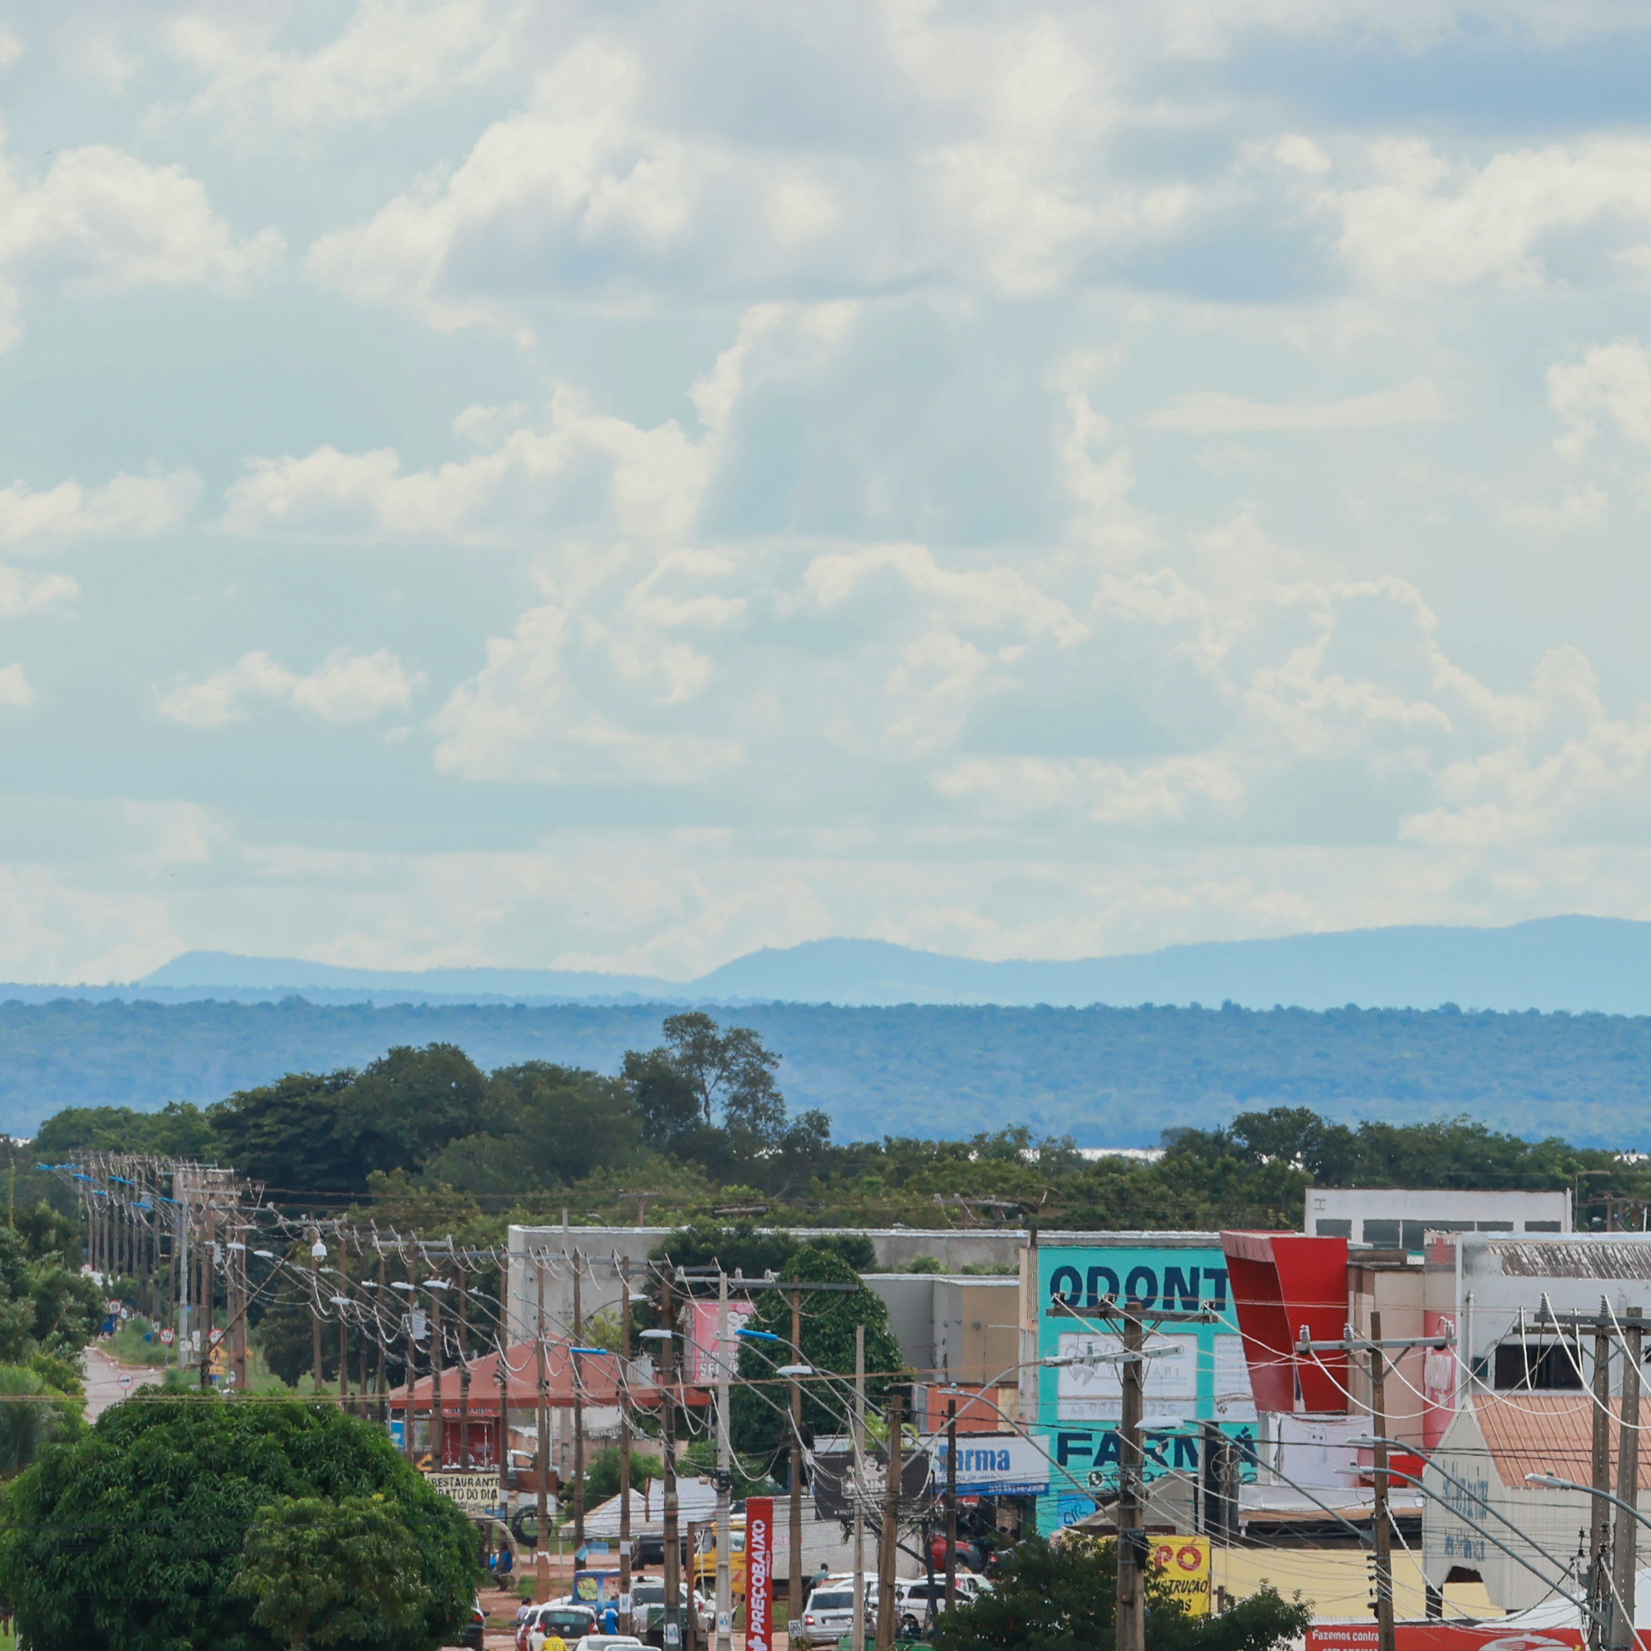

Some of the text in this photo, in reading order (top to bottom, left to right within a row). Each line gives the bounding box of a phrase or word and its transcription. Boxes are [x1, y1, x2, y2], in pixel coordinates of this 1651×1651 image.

[467, 1489, 478, 1500] DO
[481, 1489, 498, 1500] DIA
[751, 1519, 767, 1635] PREÇOBAIXO
[1312, 1629, 1350, 1641] Fazemos
